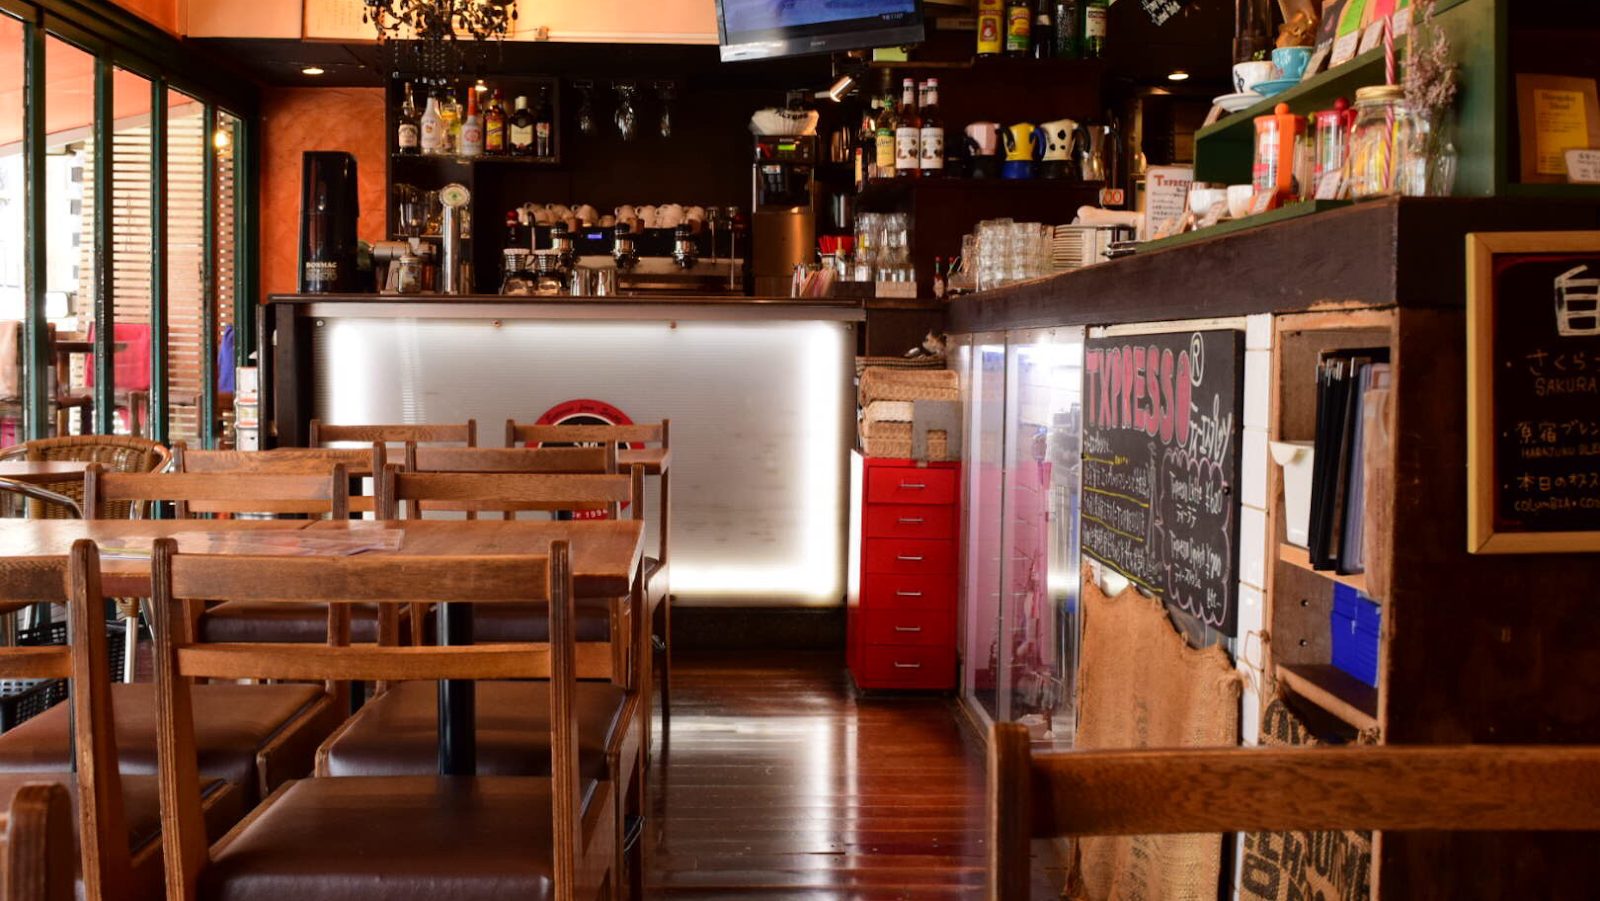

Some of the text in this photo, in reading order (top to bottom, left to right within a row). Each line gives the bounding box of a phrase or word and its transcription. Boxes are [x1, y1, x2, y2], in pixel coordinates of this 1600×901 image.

[1526, 349, 1600, 377] さくら
[1086, 345, 1191, 448] TXPRESSO
[1535, 377, 1597, 397] SAKURA
